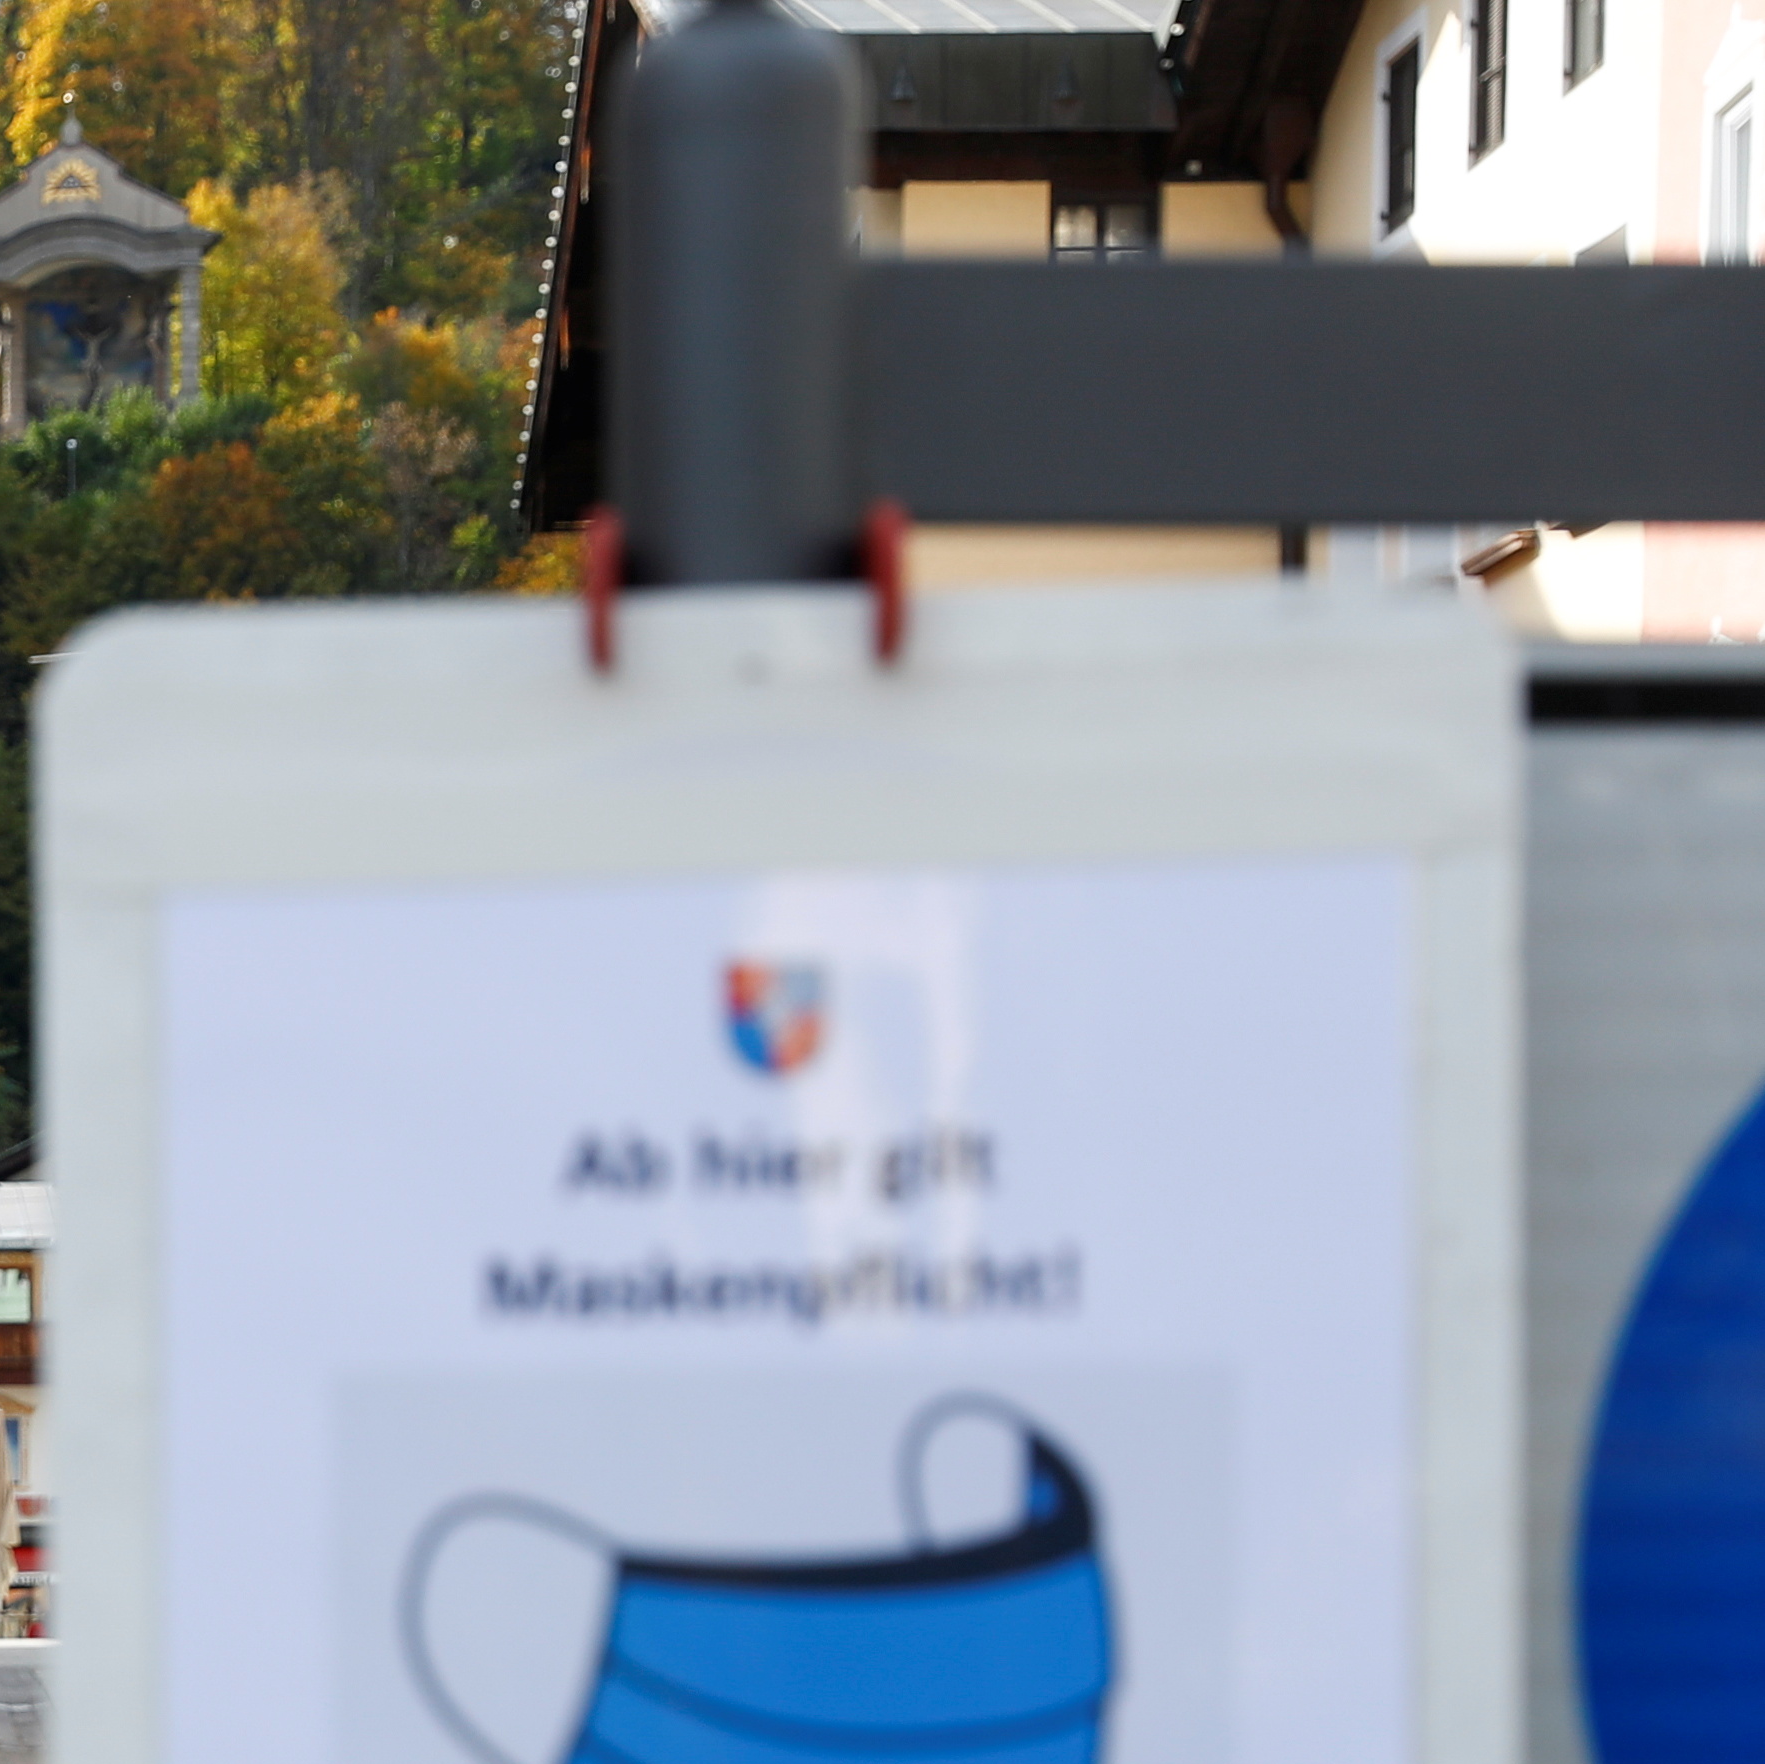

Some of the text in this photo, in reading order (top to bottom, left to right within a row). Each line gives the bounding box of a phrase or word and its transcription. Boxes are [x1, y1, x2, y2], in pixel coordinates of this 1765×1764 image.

[561, 1122, 1004, 1208] Ab hier gilt
[477, 1243, 1085, 1330] Maskenpflicht!
